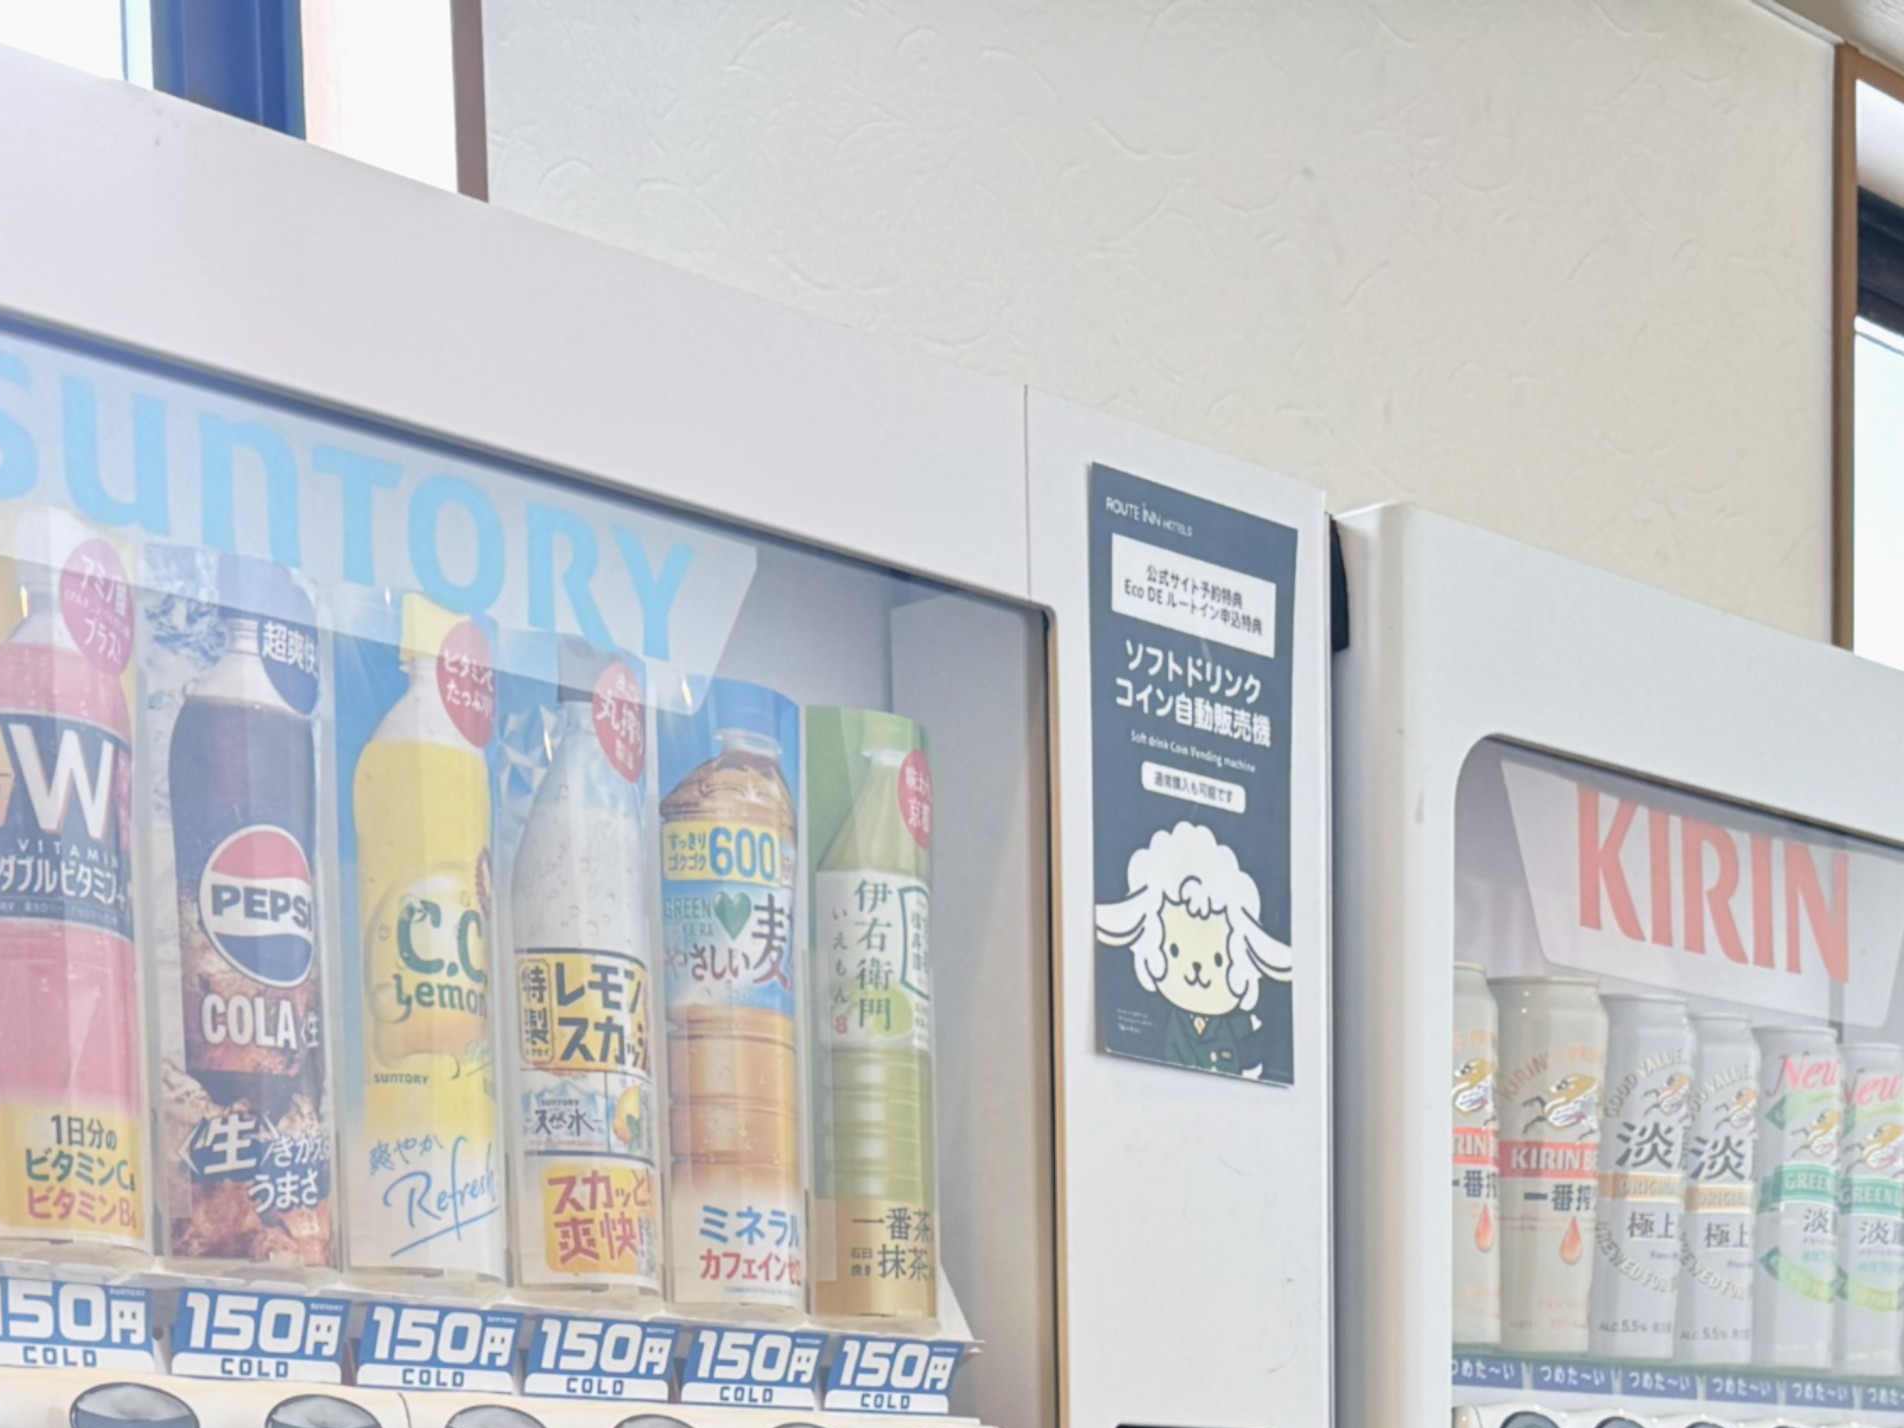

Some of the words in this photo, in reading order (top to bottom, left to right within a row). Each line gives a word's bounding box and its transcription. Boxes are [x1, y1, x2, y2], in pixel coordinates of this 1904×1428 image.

[1105, 496, 1141, 522] ROUTE
[1124, 579, 1145, 600] Eco
[1147, 588, 1165, 606] DE
[1146, 563, 1244, 610] 公式サイト予約特典
[1125, 638, 1261, 704] ソフトドリンク
[1115, 676, 1272, 747] コイン自動販売機
[1170, 740, 1189, 755] Coin
[1190, 745, 1223, 769] Vending
[8, 722, 115, 840] W
[709, 826, 776, 882] 600
[1576, 781, 1851, 984] KIRIN
[853, 877, 895, 1032] 伊右衛門
[201, 993, 297, 1050] COLA
[374, 1073, 429, 1085] SUNTORY
[51, 1114, 118, 1151] 1日分の
[1511, 1147, 1580, 1171] KIRIN
[249, 1170, 319, 1215] うまさ
[1626, 1210, 1676, 1239] 極上
[22, 1344, 98, 1368] COLD
[373, 1304, 515, 1367] 150円
[540, 1316, 672, 1376] 150円
[220, 1357, 290, 1380] COLD
[698, 1327, 819, 1386] 150円
[842, 1336, 955, 1392] 150円
[402, 1366, 466, 1389] COLD
[565, 1376, 626, 1397] COLD
[719, 1384, 775, 1404] COLD
[860, 1391, 912, 1411] COLD
